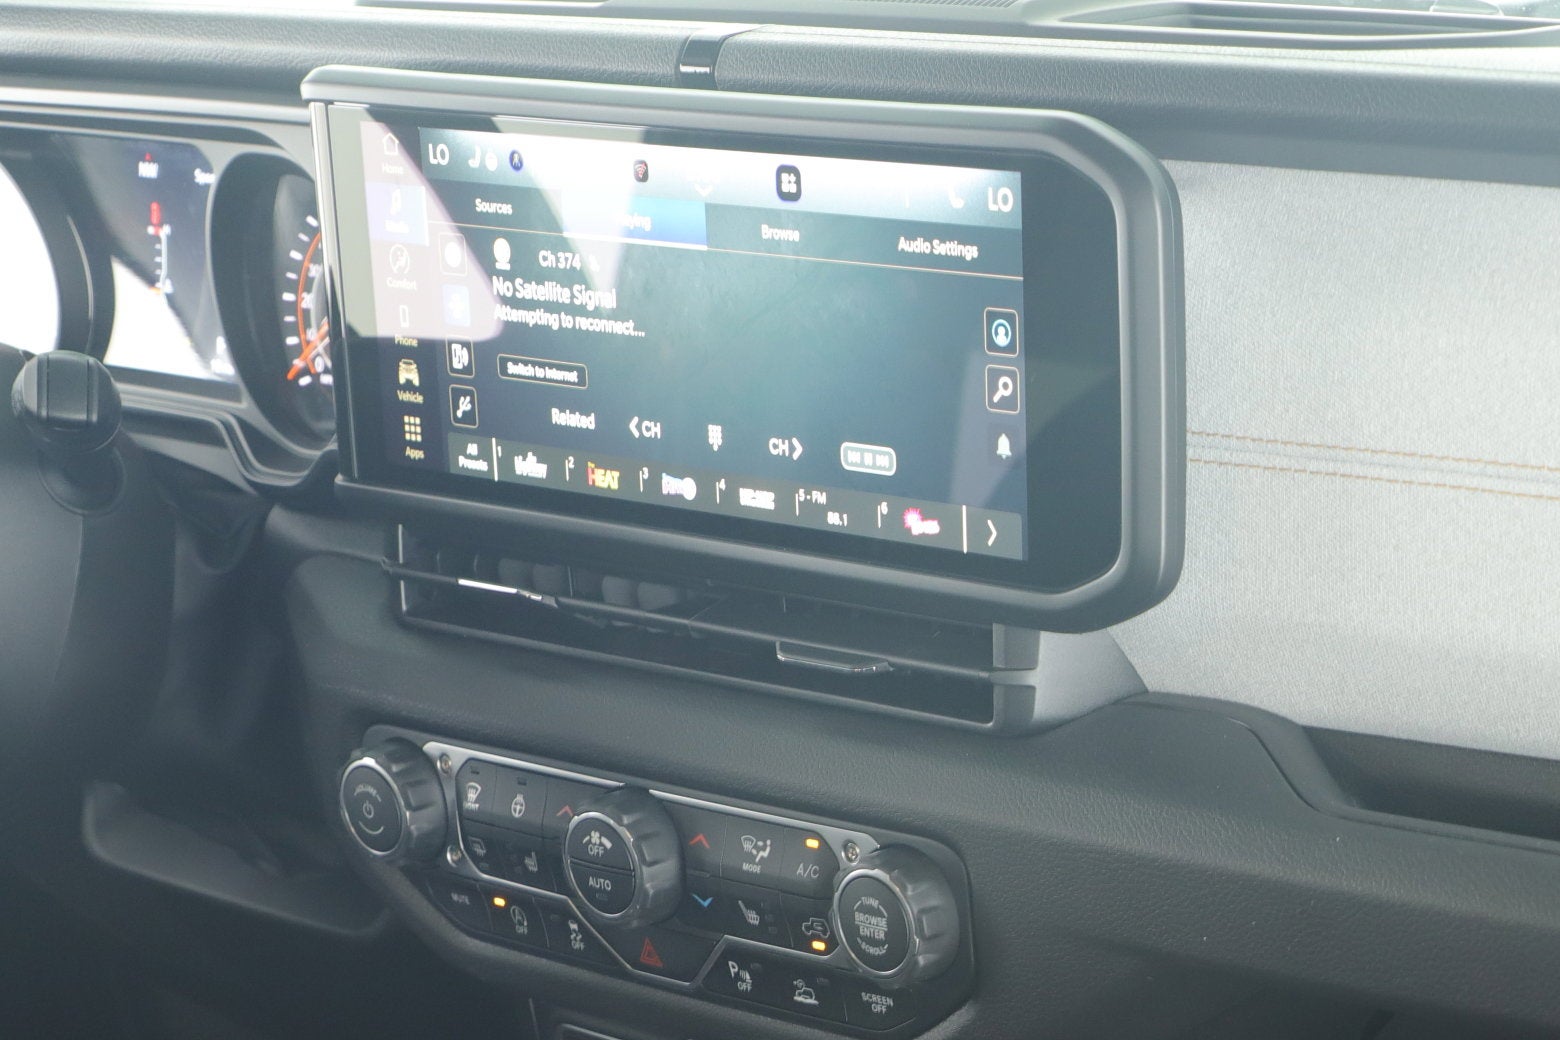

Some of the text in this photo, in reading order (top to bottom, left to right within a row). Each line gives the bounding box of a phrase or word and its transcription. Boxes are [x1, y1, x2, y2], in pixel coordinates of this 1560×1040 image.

[428, 143, 449, 166] LO
[475, 198, 513, 216] Sources
[987, 186, 1014, 213] LO
[761, 224, 800, 242] Browse
[898, 236, 979, 261] Audio Settings
[538, 250, 581, 270] Ch 374
[492, 276, 617, 310] No Satellite Signal
[494, 303, 646, 337] Attempting to reconnect...
[394, 334, 419, 348] Phone
[507, 361, 533, 376] Switch
[534, 365, 545, 378] to
[397, 390, 424, 404] Vehicle
[551, 408, 596, 431] Related
[641, 420, 662, 440] CH
[405, 446, 425, 460] Apps
[768, 438, 789, 457] CH
[811, 491, 827, 505] FM
[587, 844, 605, 857] OFF
[742, 863, 762, 874] MODE
[796, 863, 820, 879] A/C
[588, 876, 612, 892] AUTO
[861, 896, 880, 909] TUNE
[854, 911, 888, 928] BROWSE
[859, 926, 885, 941] ENTER
[737, 981, 753, 992] OFF
[861, 992, 894, 1008] SCREEN
[871, 1002, 888, 1015] OFF
